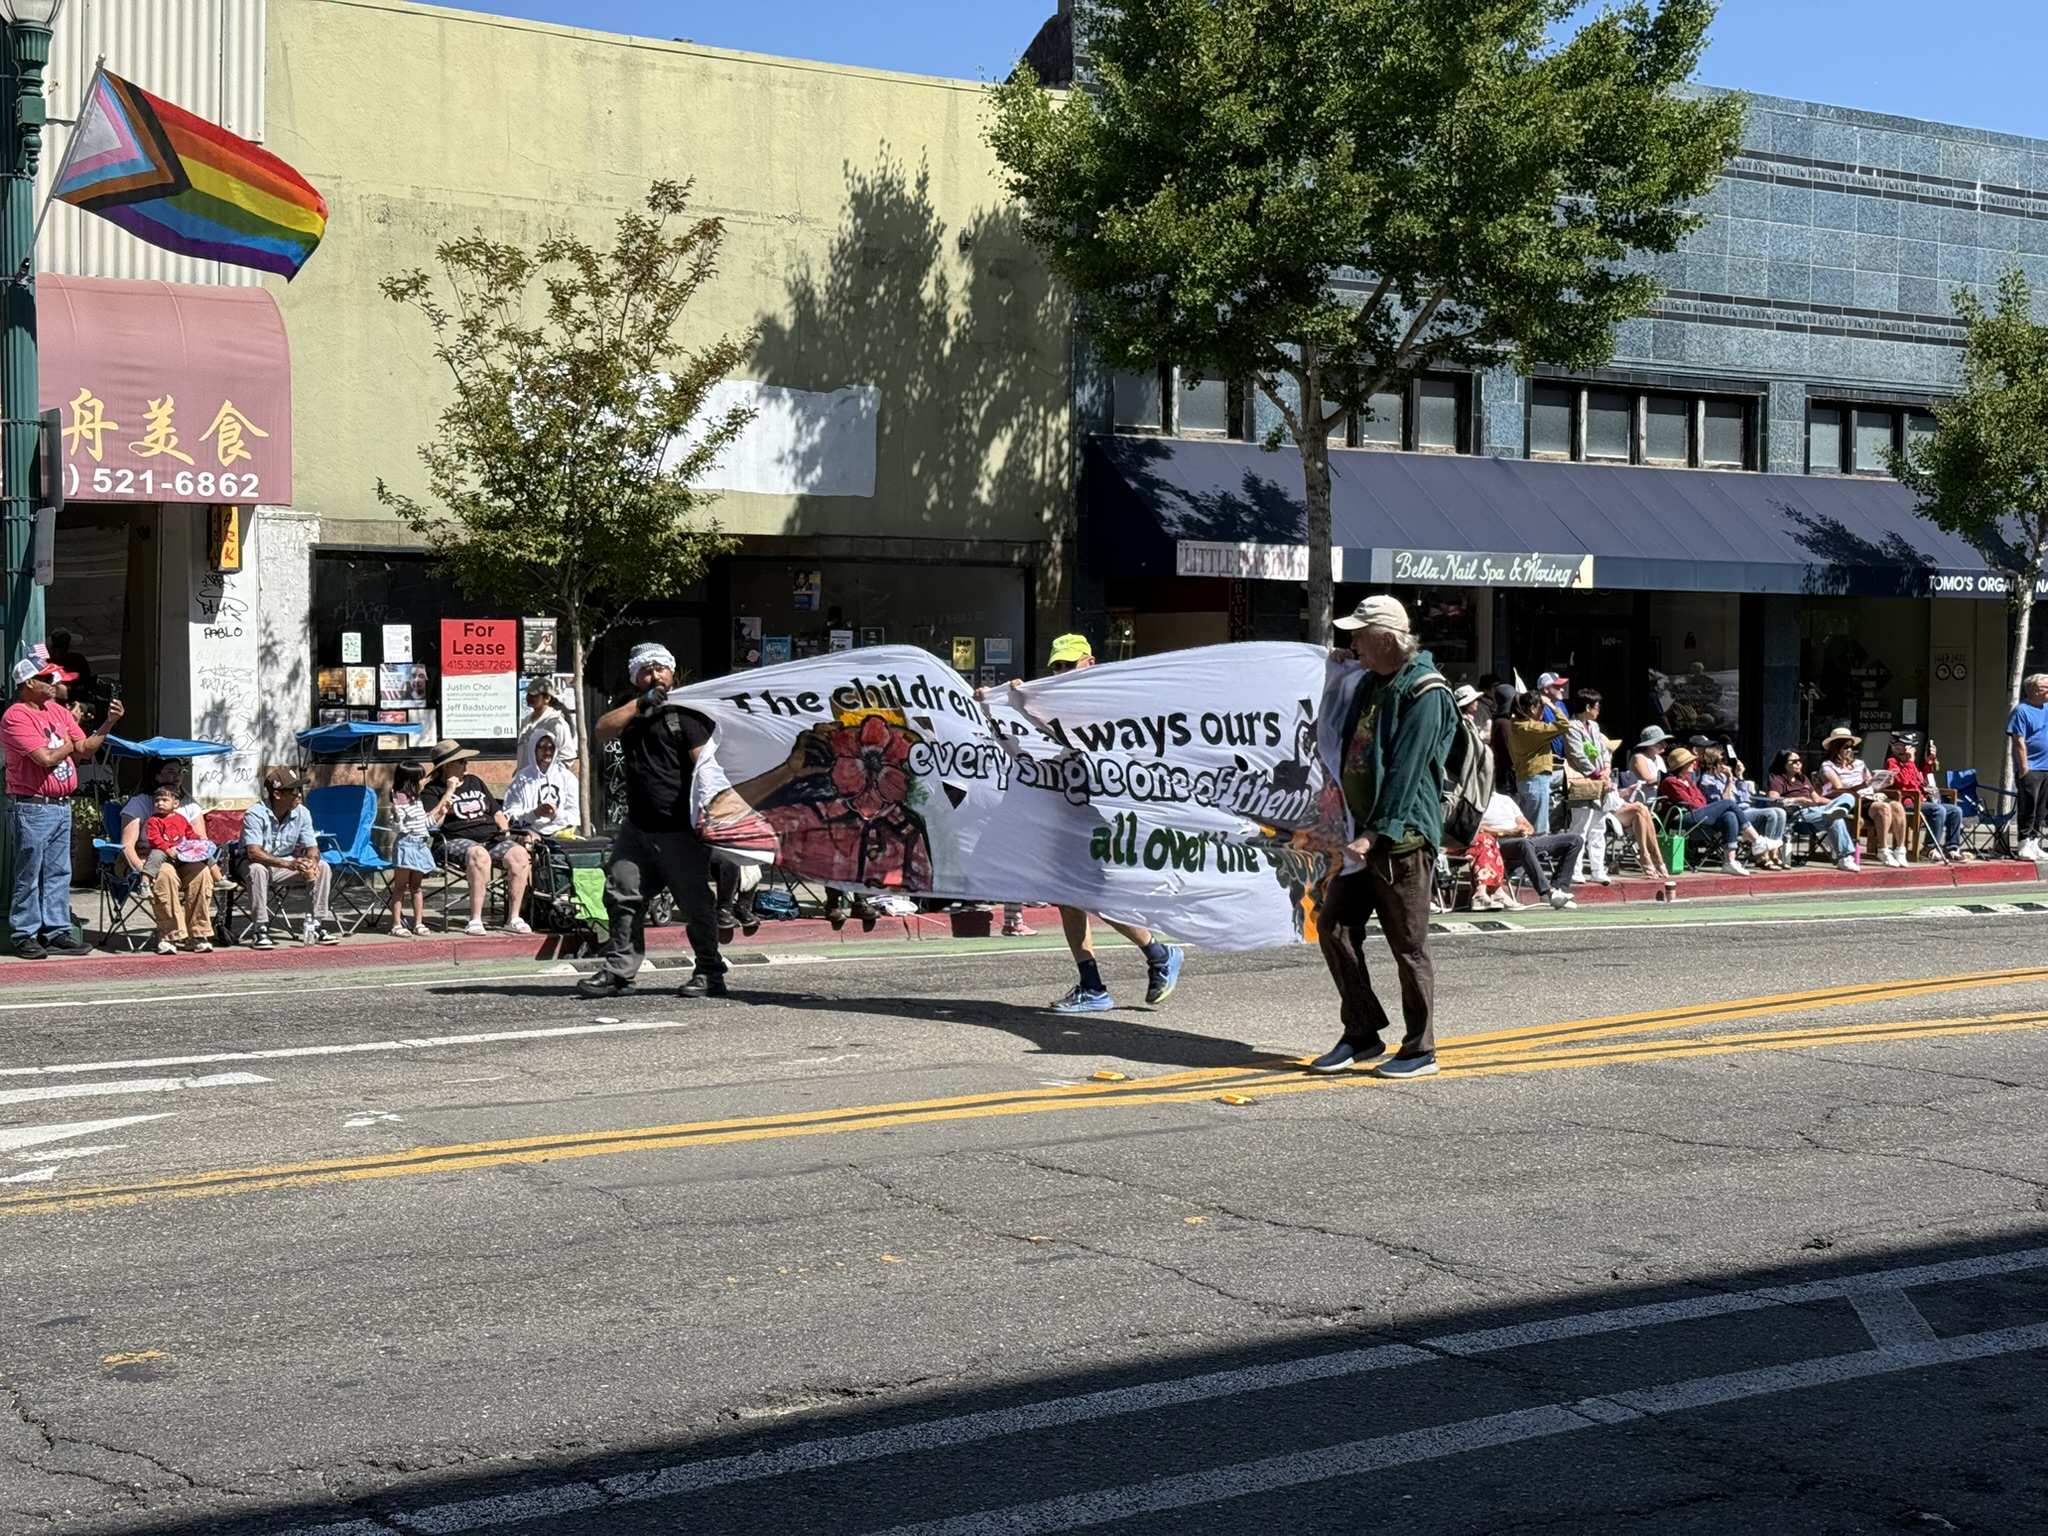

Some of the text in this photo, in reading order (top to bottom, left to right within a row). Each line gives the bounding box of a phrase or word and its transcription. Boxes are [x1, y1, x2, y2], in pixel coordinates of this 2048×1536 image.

[93, 467, 259, 498] 521-6862
[1184, 548, 1234, 574] LITTLE
[1395, 552, 1572, 587] Bella Nail Spa & Waxing
[1929, 575, 1974, 591] TOMO'S
[1234, 577, 1243, 638] RTUNE
[464, 622, 495, 637] For
[453, 640, 505, 655] Lease
[446, 660, 512, 670] 415.395.7262
[473, 683, 491, 691] Choi
[446, 703, 506, 711] Jeff Badstubner
[720, 690, 824, 716] The
[831, 674, 981, 726] children
[1201, 712, 1282, 747] ours
[908, 741, 1312, 821] every single one of them
[1089, 811, 1138, 867] all
[1144, 827, 1210, 873] over
[1210, 831, 1261, 874] the
